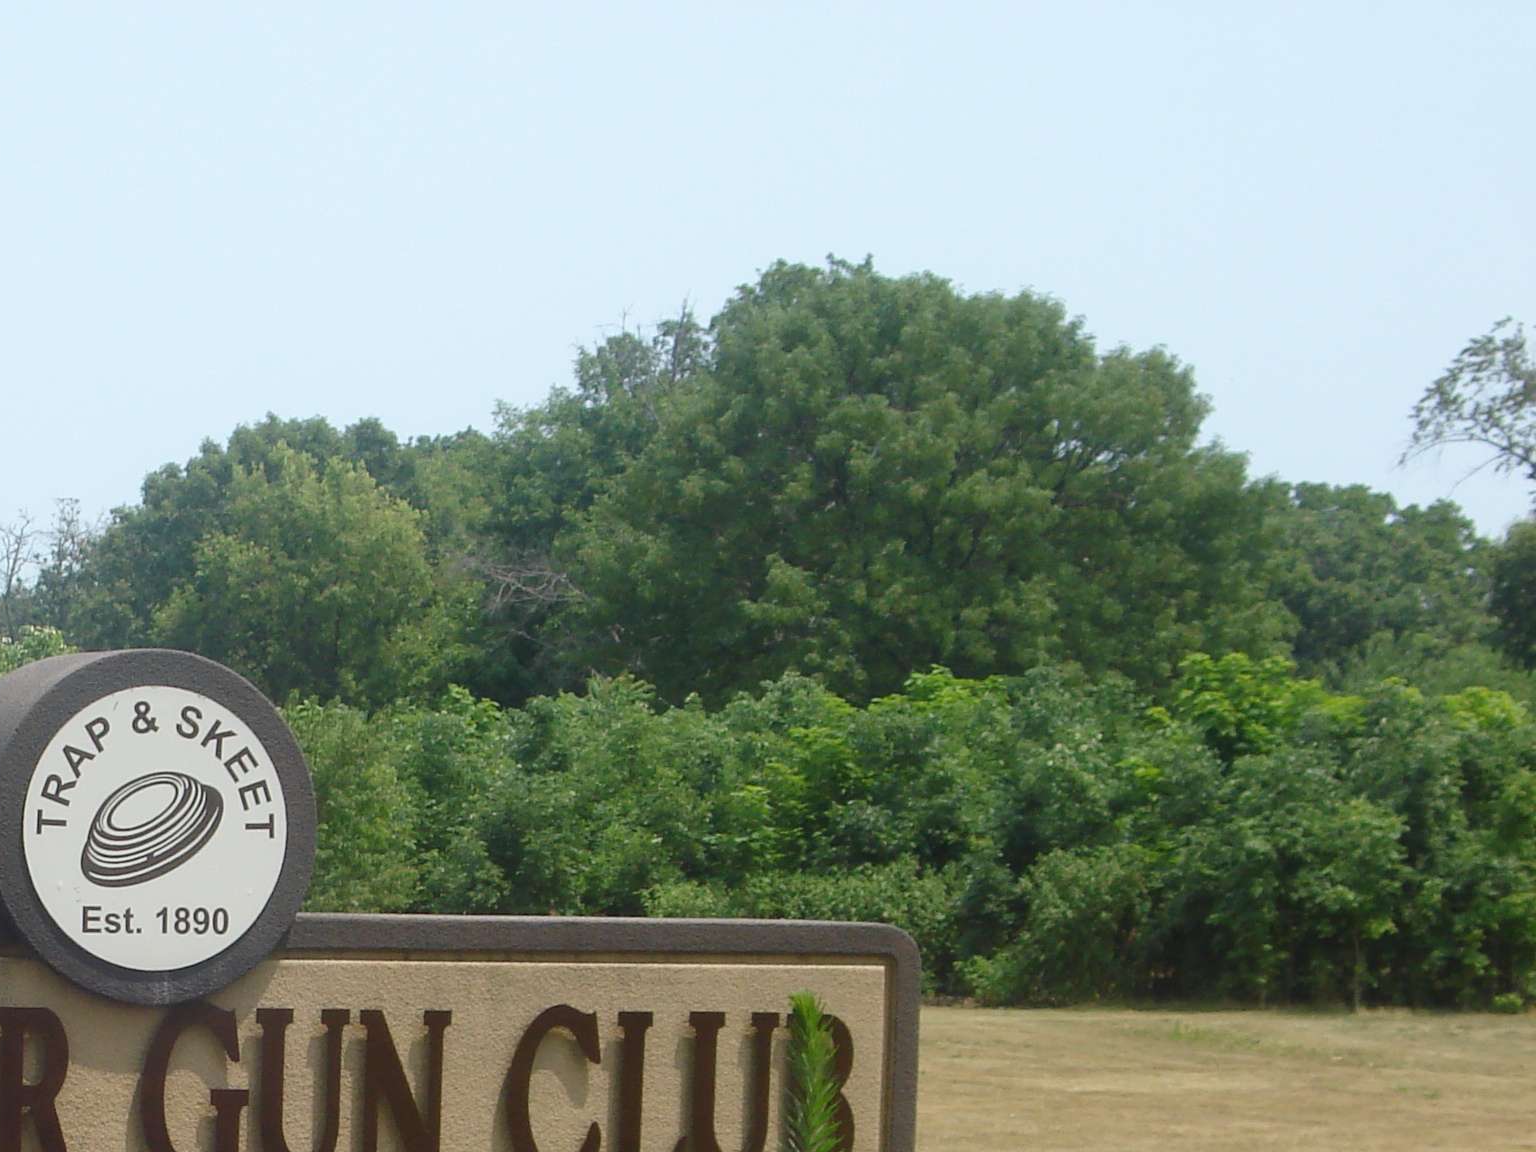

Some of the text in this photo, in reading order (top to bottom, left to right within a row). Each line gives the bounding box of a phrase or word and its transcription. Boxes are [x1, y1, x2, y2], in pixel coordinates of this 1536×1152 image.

[36, 701, 275, 839] TRAP & SKEET
[81, 906, 229, 935] Est. 1890
